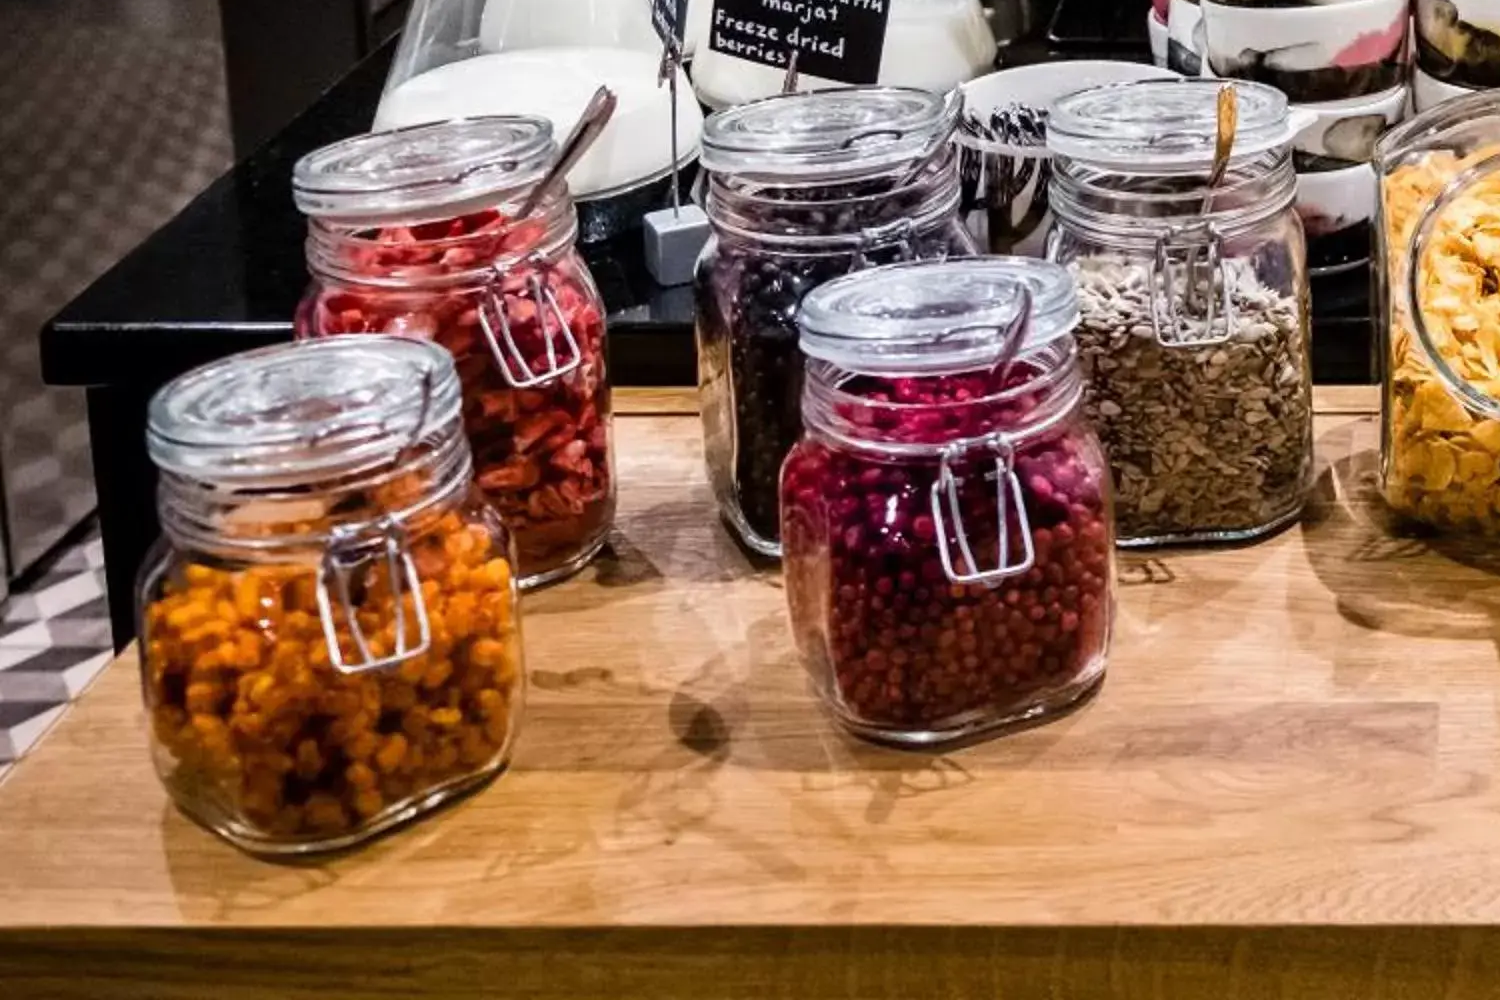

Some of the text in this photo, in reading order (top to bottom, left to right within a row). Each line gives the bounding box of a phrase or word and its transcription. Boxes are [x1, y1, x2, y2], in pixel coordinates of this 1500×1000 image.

[715, 8, 845, 59] Freeze dried
[715, 32, 787, 63] berries
